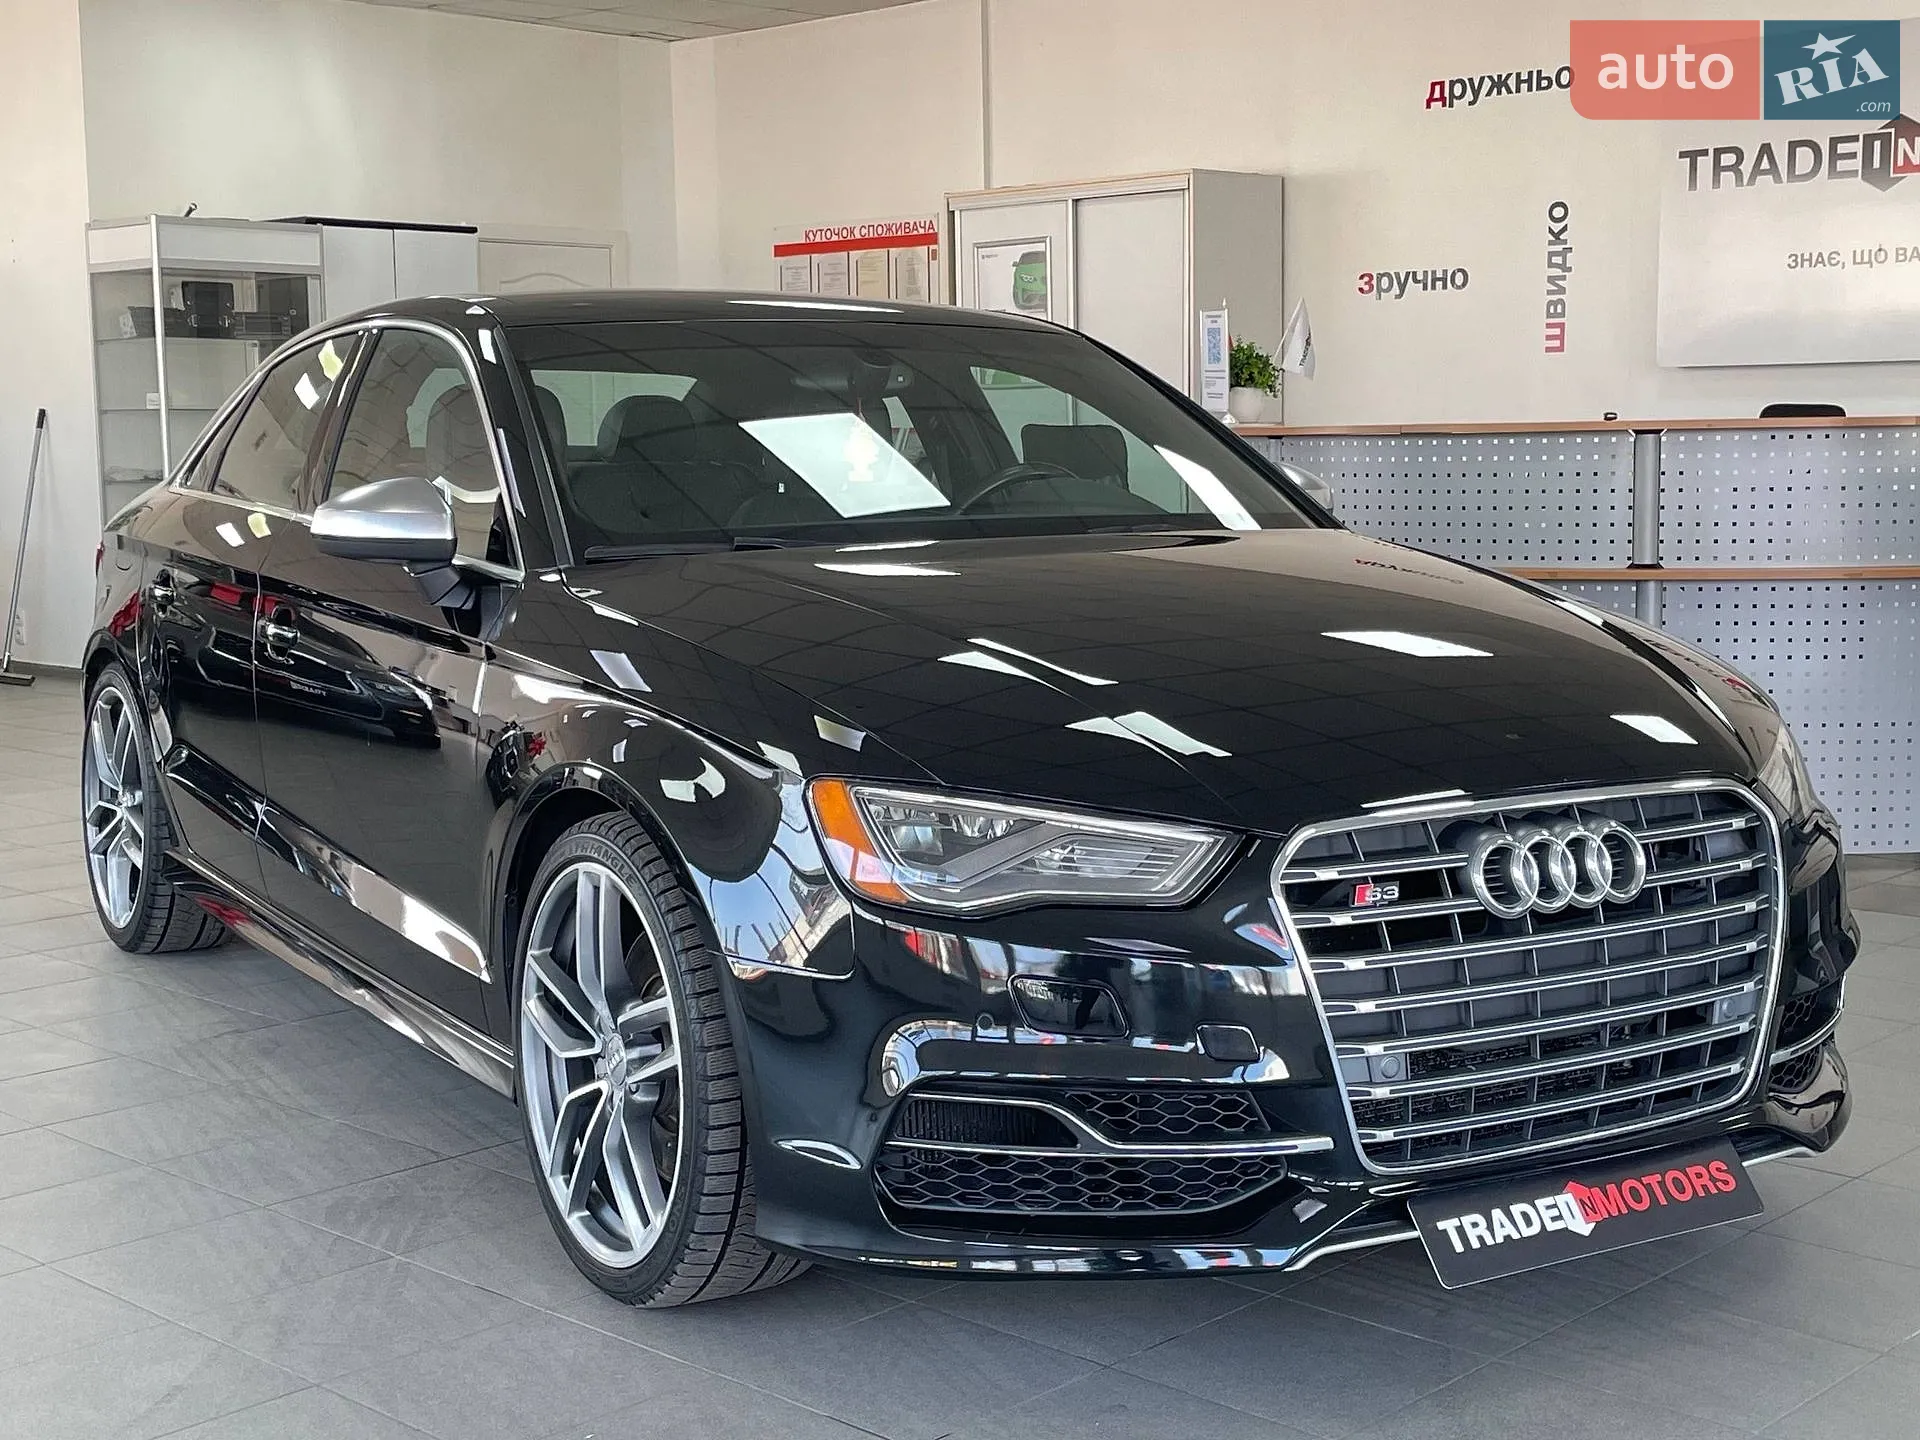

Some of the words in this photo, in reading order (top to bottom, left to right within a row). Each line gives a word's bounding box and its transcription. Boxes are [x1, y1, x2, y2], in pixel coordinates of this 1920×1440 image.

[1425, 65, 1575, 109] дружньо
[804, 224, 857, 243] КУТОЧОК
[858, 219, 936, 239] СПОЖИВАЧА
[1786, 250, 1846, 270] ЗНАЄ,
[1358, 267, 1470, 301] зручно
[1365, 884, 1400, 902] S3
